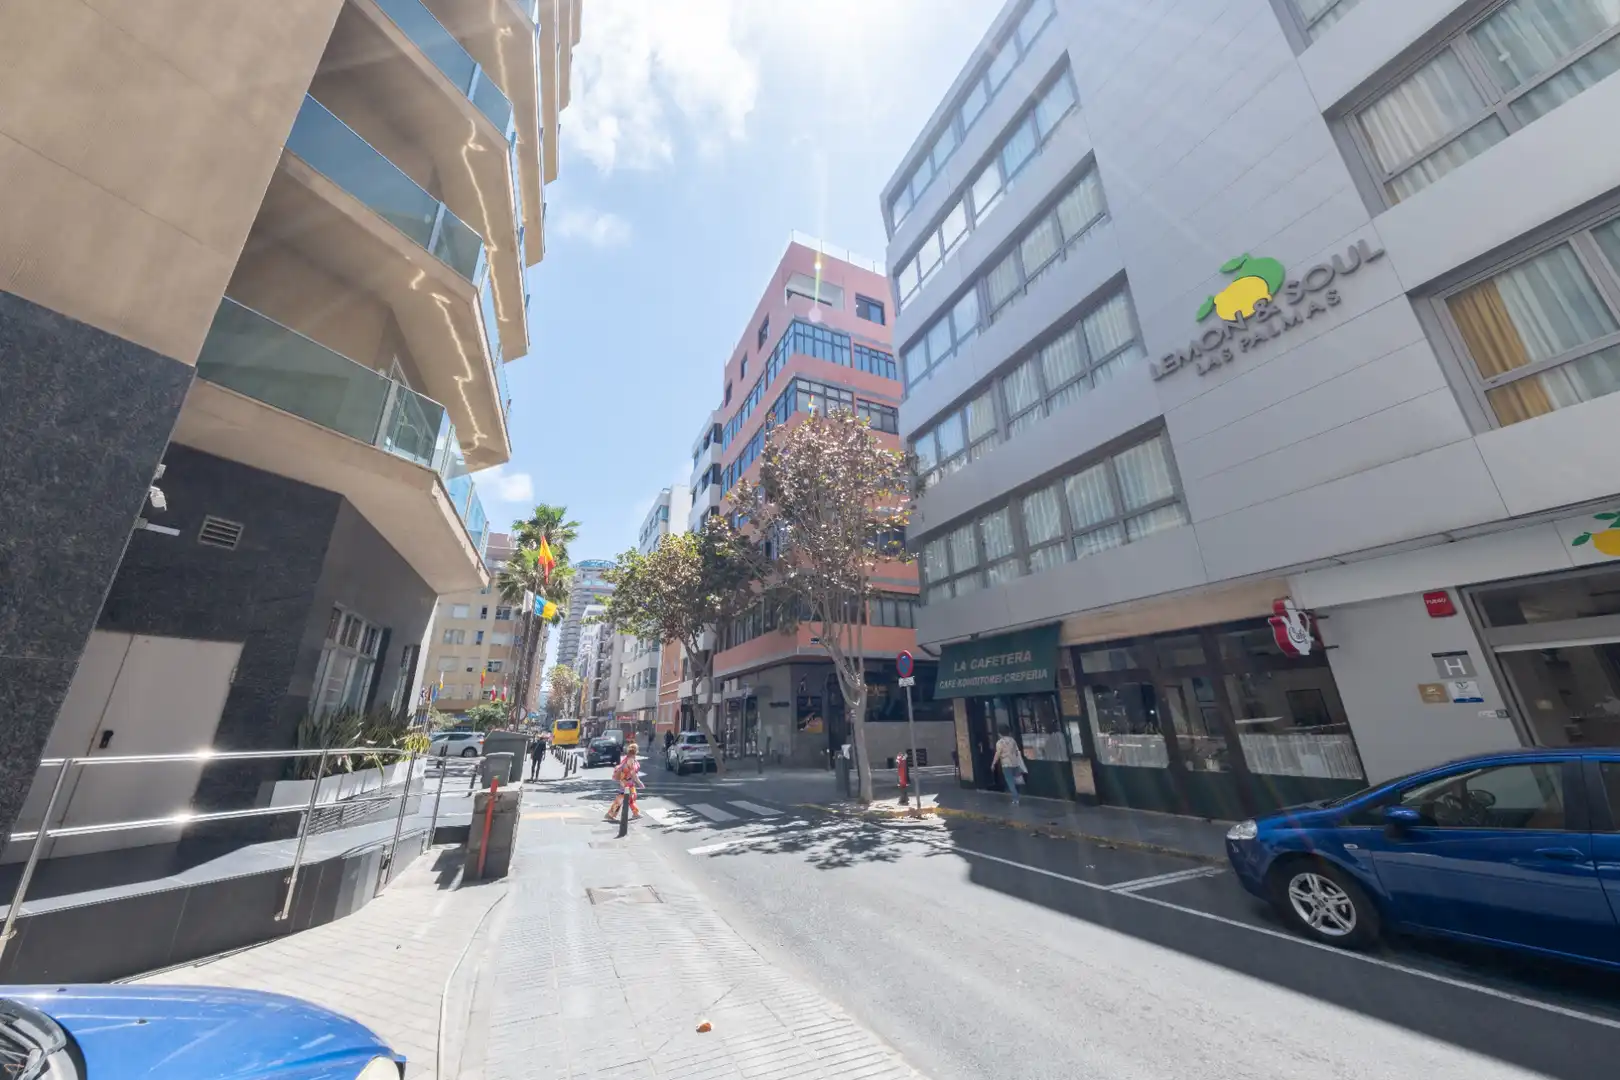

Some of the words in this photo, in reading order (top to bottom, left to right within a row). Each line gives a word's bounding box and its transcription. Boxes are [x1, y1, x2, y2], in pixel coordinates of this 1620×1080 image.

[1151, 309, 1248, 381] LEMON
[1253, 298, 1281, 323] &
[1285, 239, 1385, 305] SOUL
[1197, 349, 1234, 376] LAS
[1240, 289, 1341, 353] PALMAS
[953, 661, 967, 673] LA
[970, 650, 1031, 670] CAFETERA
[1444, 658, 1467, 676] H
